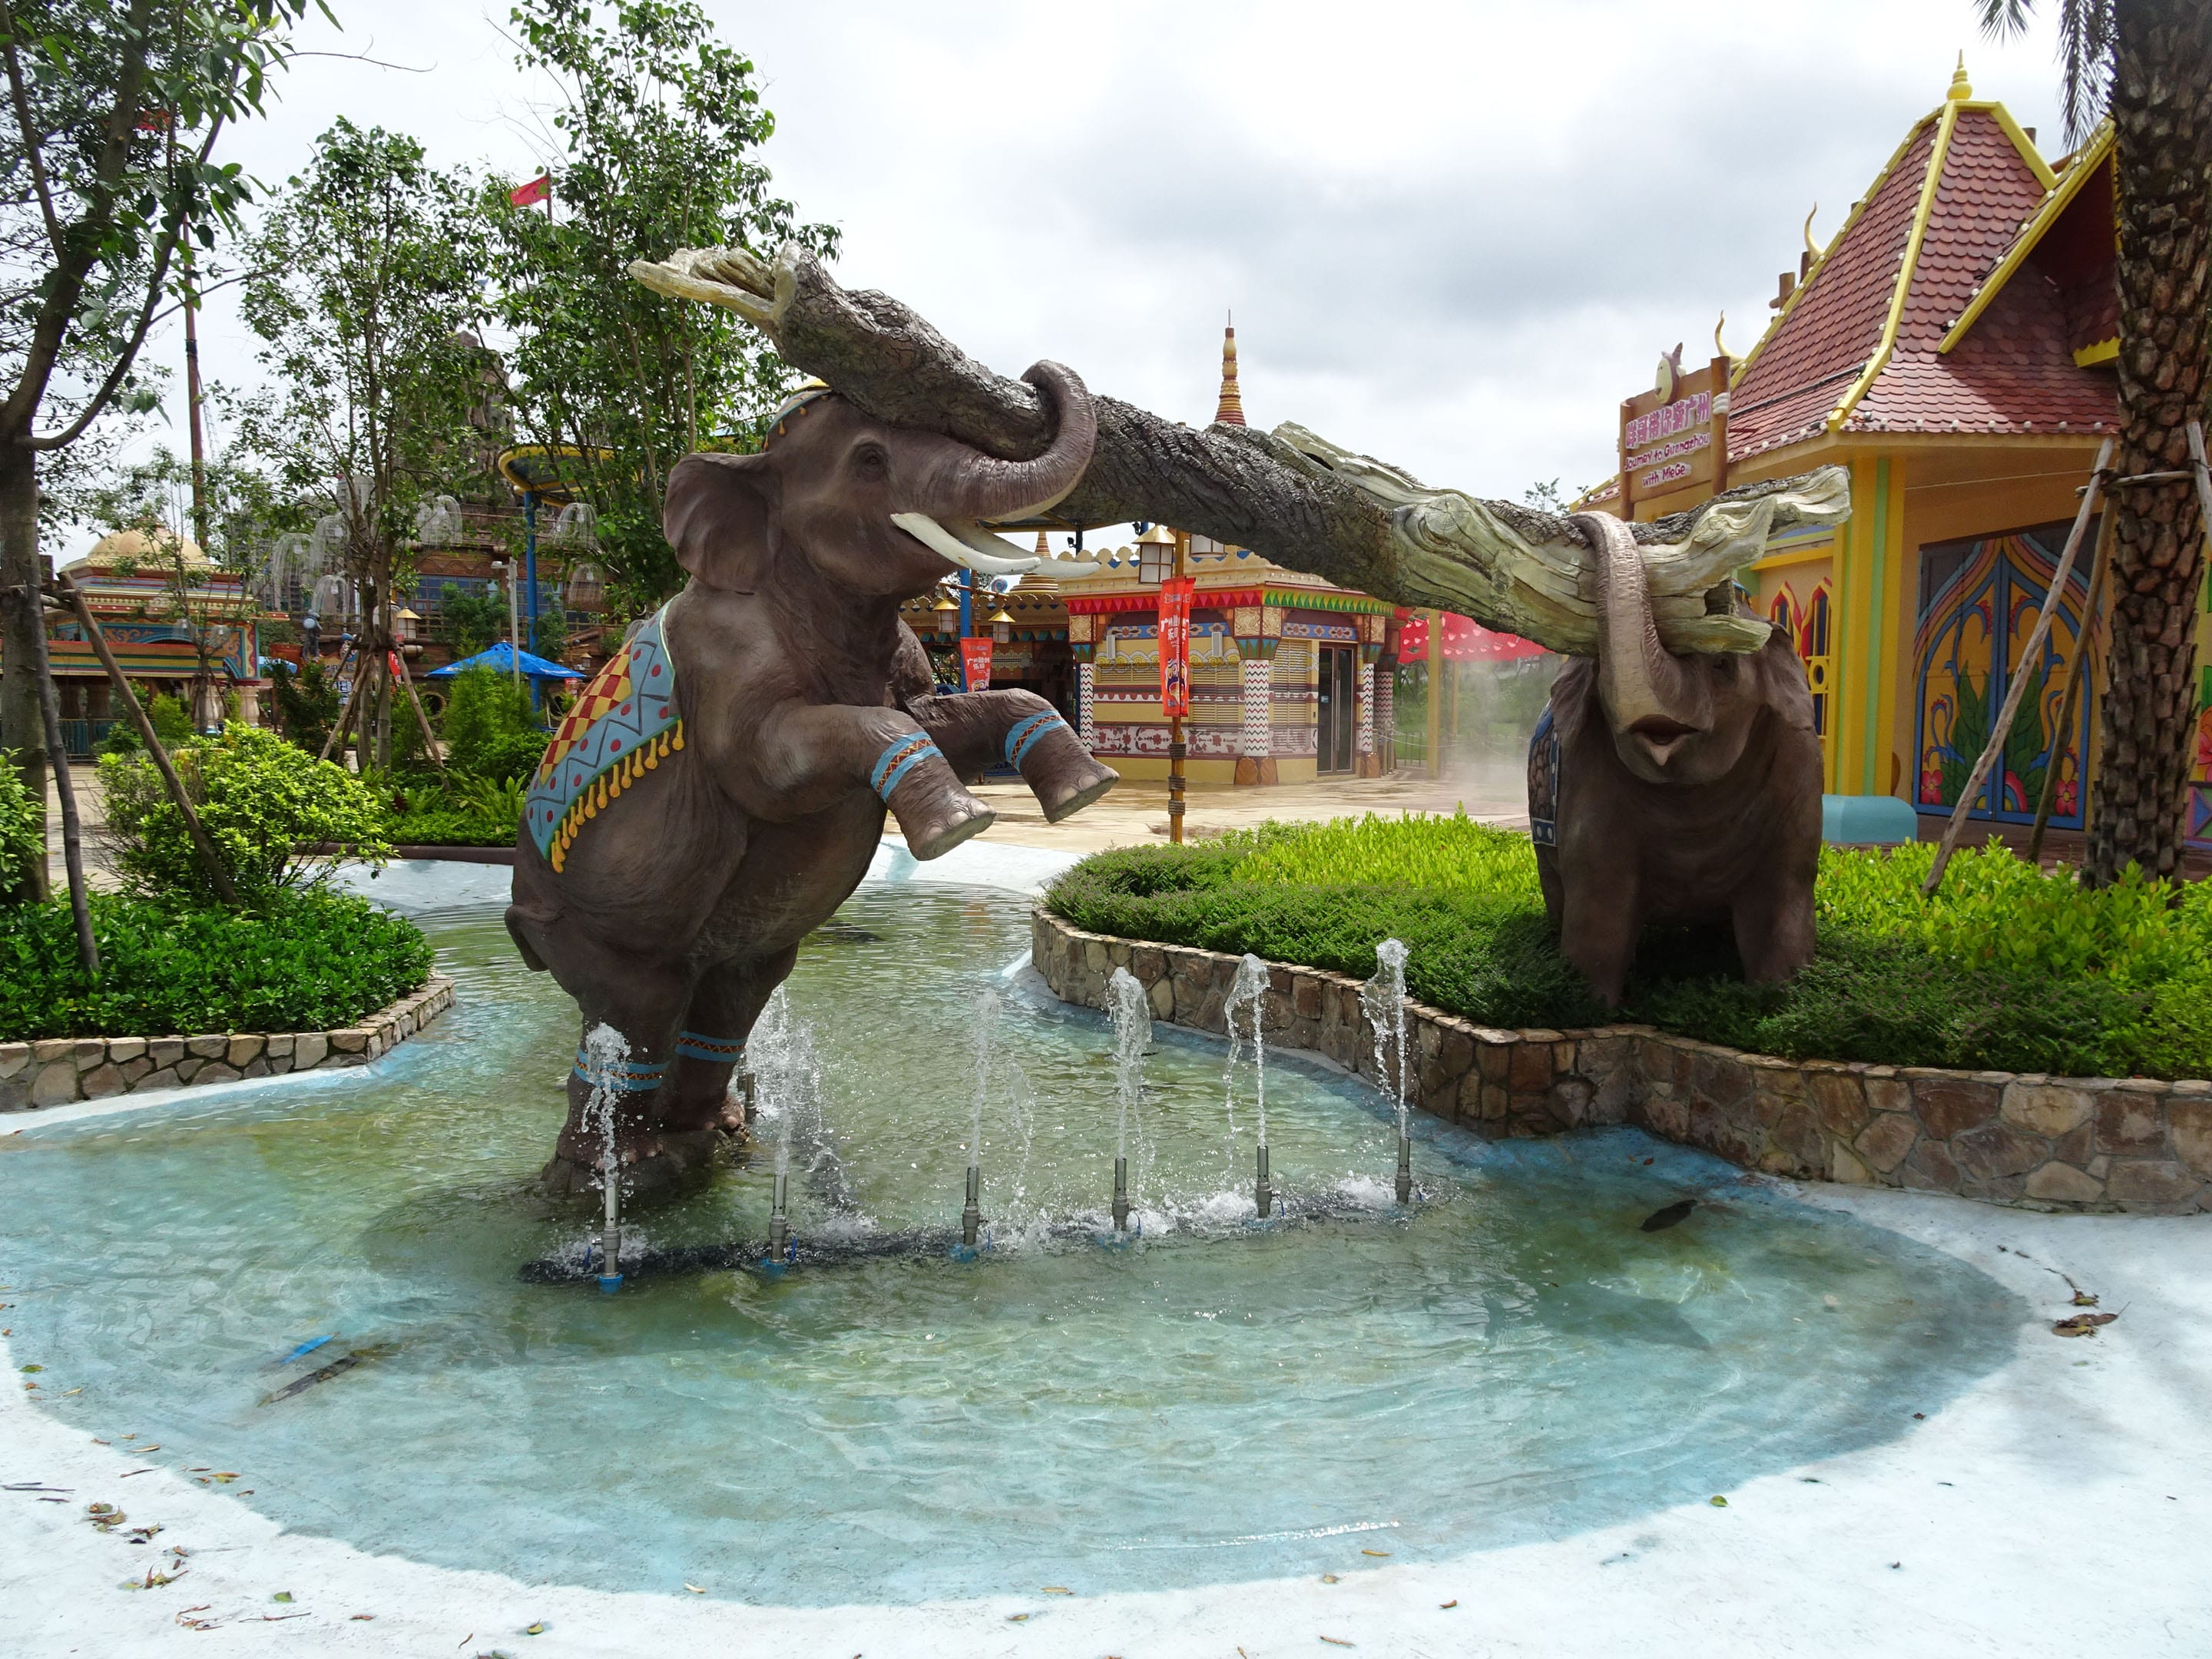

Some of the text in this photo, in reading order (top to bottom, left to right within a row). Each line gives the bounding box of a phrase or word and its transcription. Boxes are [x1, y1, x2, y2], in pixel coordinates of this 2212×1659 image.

[1625, 434, 1710, 470] Journey to Guangzhou
[1643, 472, 1659, 486] with
